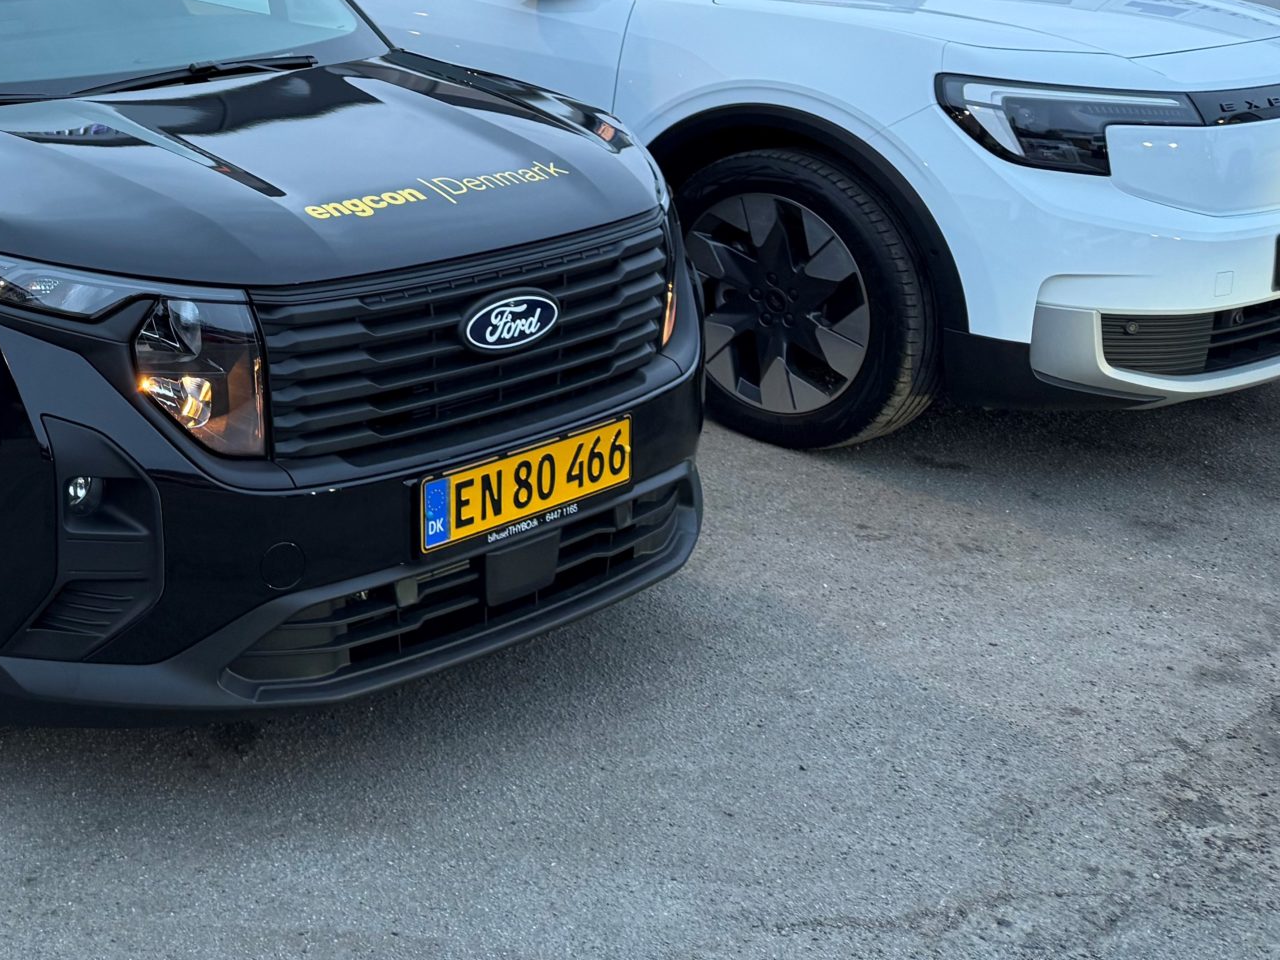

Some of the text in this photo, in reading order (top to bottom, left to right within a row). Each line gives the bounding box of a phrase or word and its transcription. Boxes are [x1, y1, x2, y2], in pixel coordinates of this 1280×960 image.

[304, 160, 570, 220] engcon Denmark
[485, 303, 541, 343] Ford
[428, 428, 627, 536] DK EN 80 466
